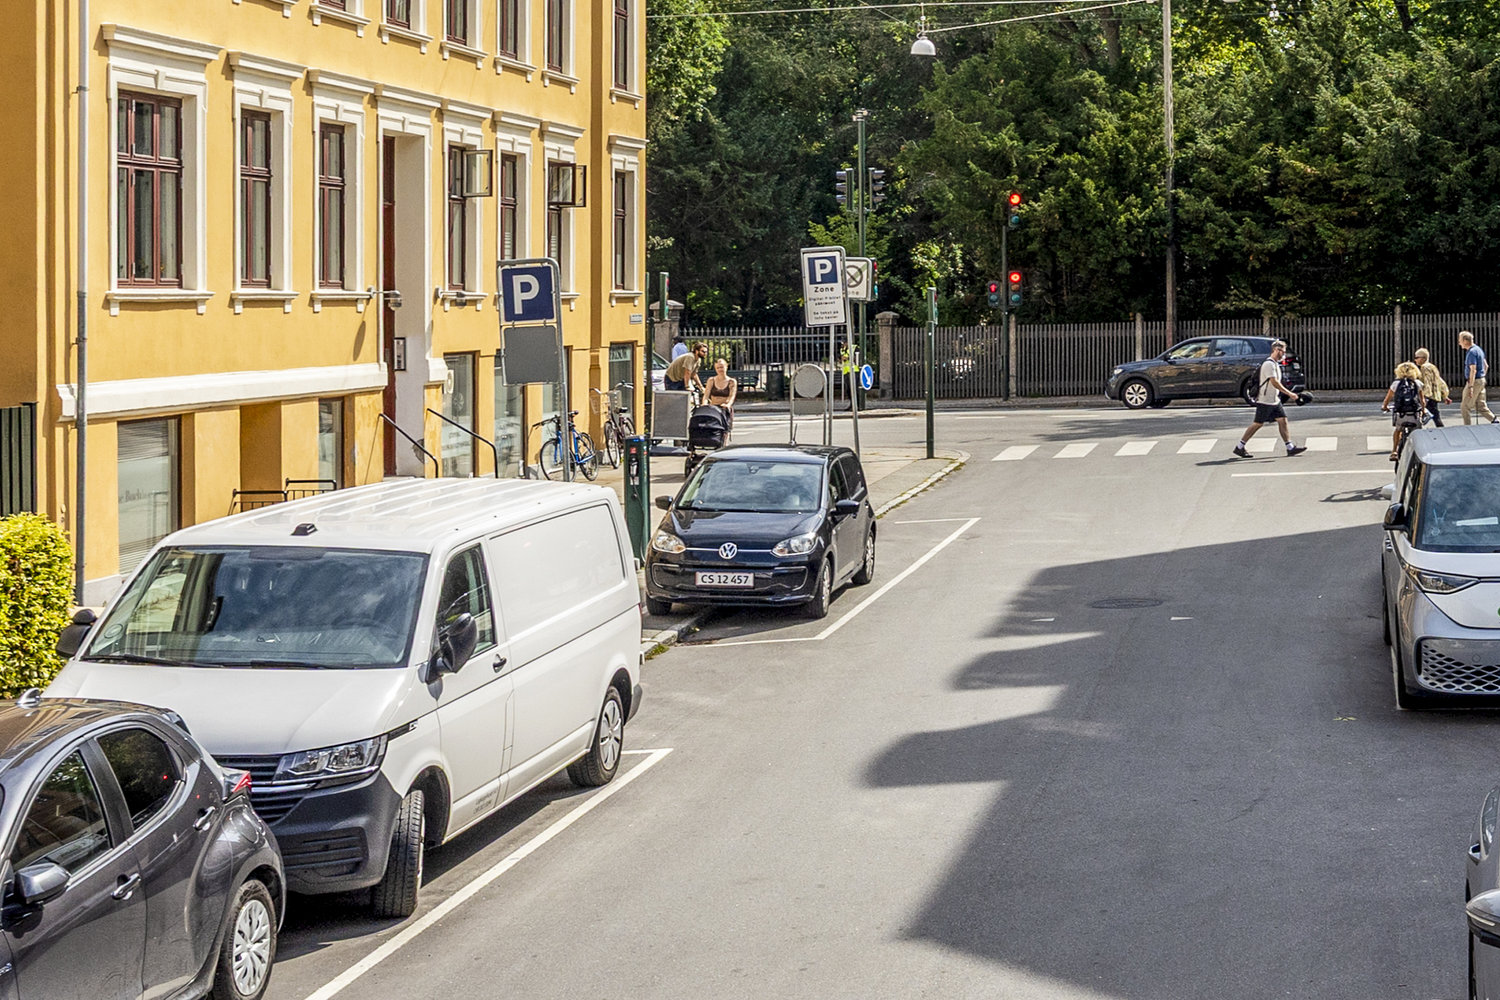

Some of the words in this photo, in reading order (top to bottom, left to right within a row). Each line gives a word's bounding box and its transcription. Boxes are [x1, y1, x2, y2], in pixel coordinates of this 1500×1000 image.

[814, 259, 832, 282] P
[512, 274, 540, 315] P
[701, 574, 715, 584] CS
[717, 575, 729, 584] 12
[731, 575, 749, 585] 457
